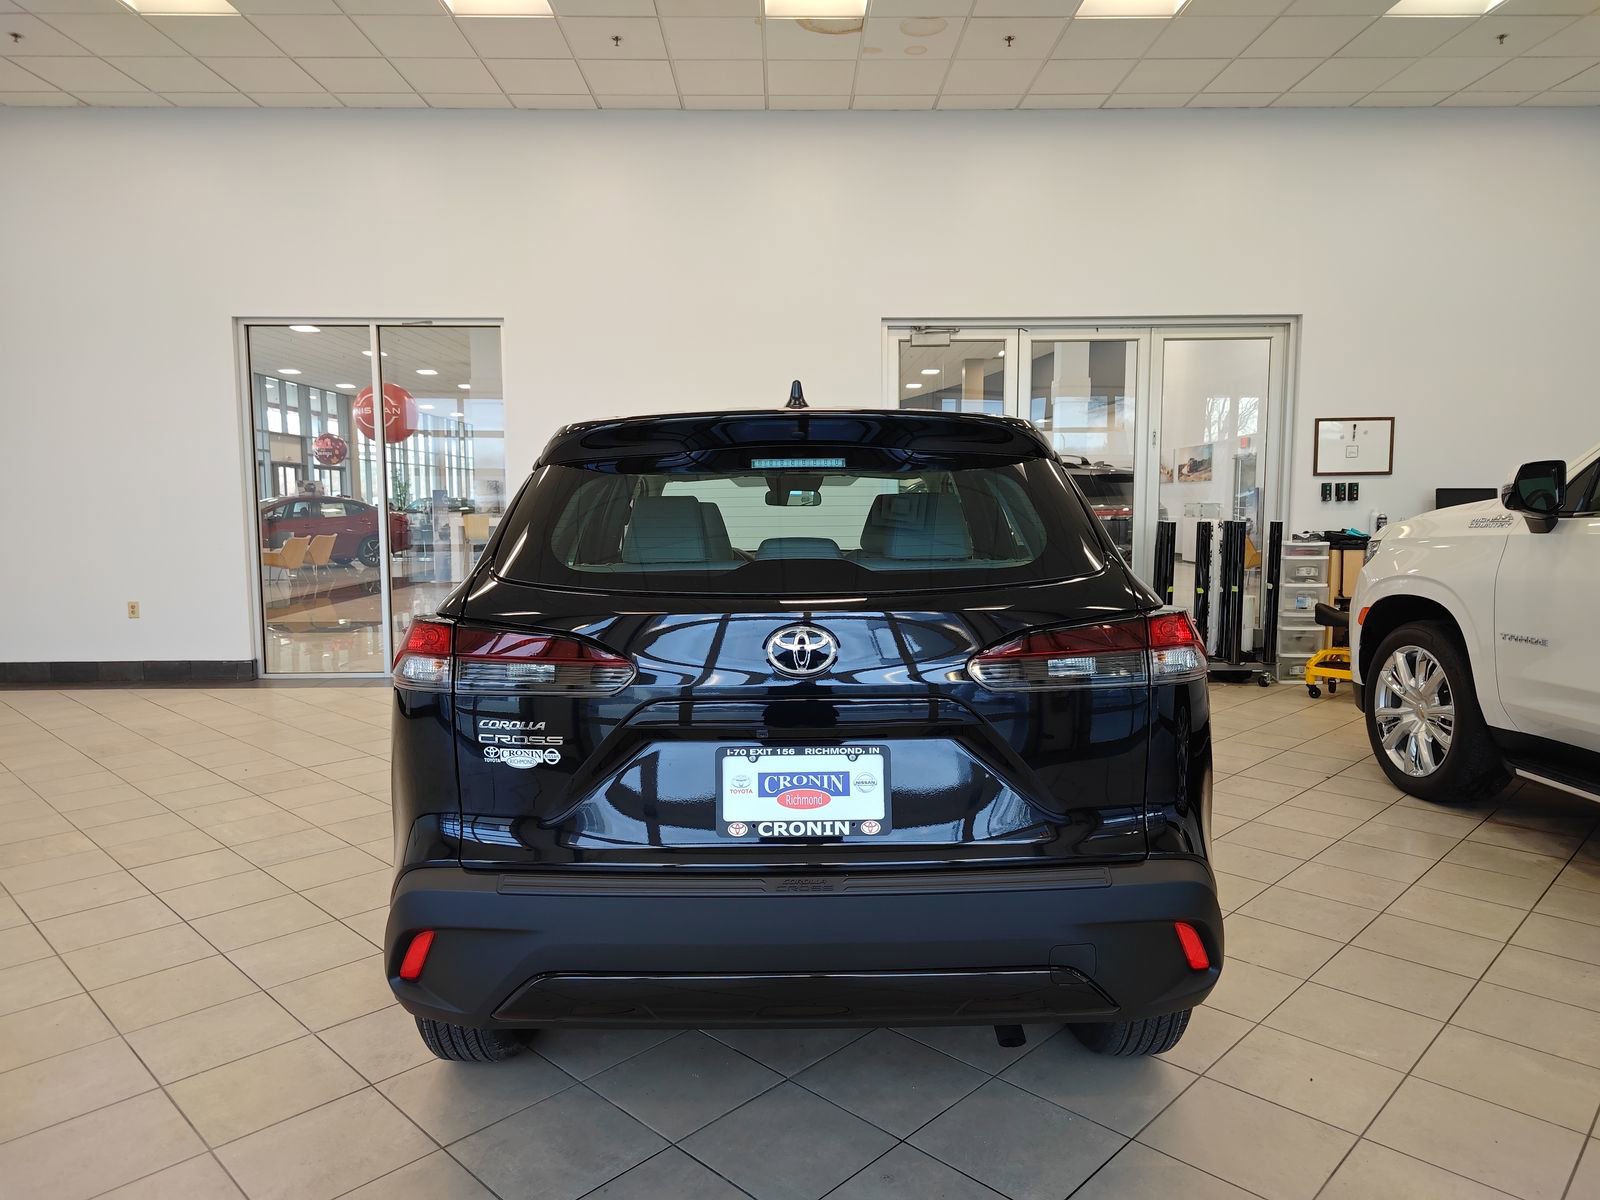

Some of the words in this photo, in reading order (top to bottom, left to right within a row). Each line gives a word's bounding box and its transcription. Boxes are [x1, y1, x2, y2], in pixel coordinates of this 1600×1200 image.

[354, 407, 401, 415] NISAN
[478, 719, 546, 731] COROLLA
[478, 733, 564, 746] CROSS
[501, 749, 542, 759] CRONIN
[726, 748, 747, 756] I-70
[749, 748, 772, 756] EXIT
[763, 774, 845, 795] CRONIN
[785, 794, 823, 807] Richmond
[757, 821, 850, 837] CRONIN
